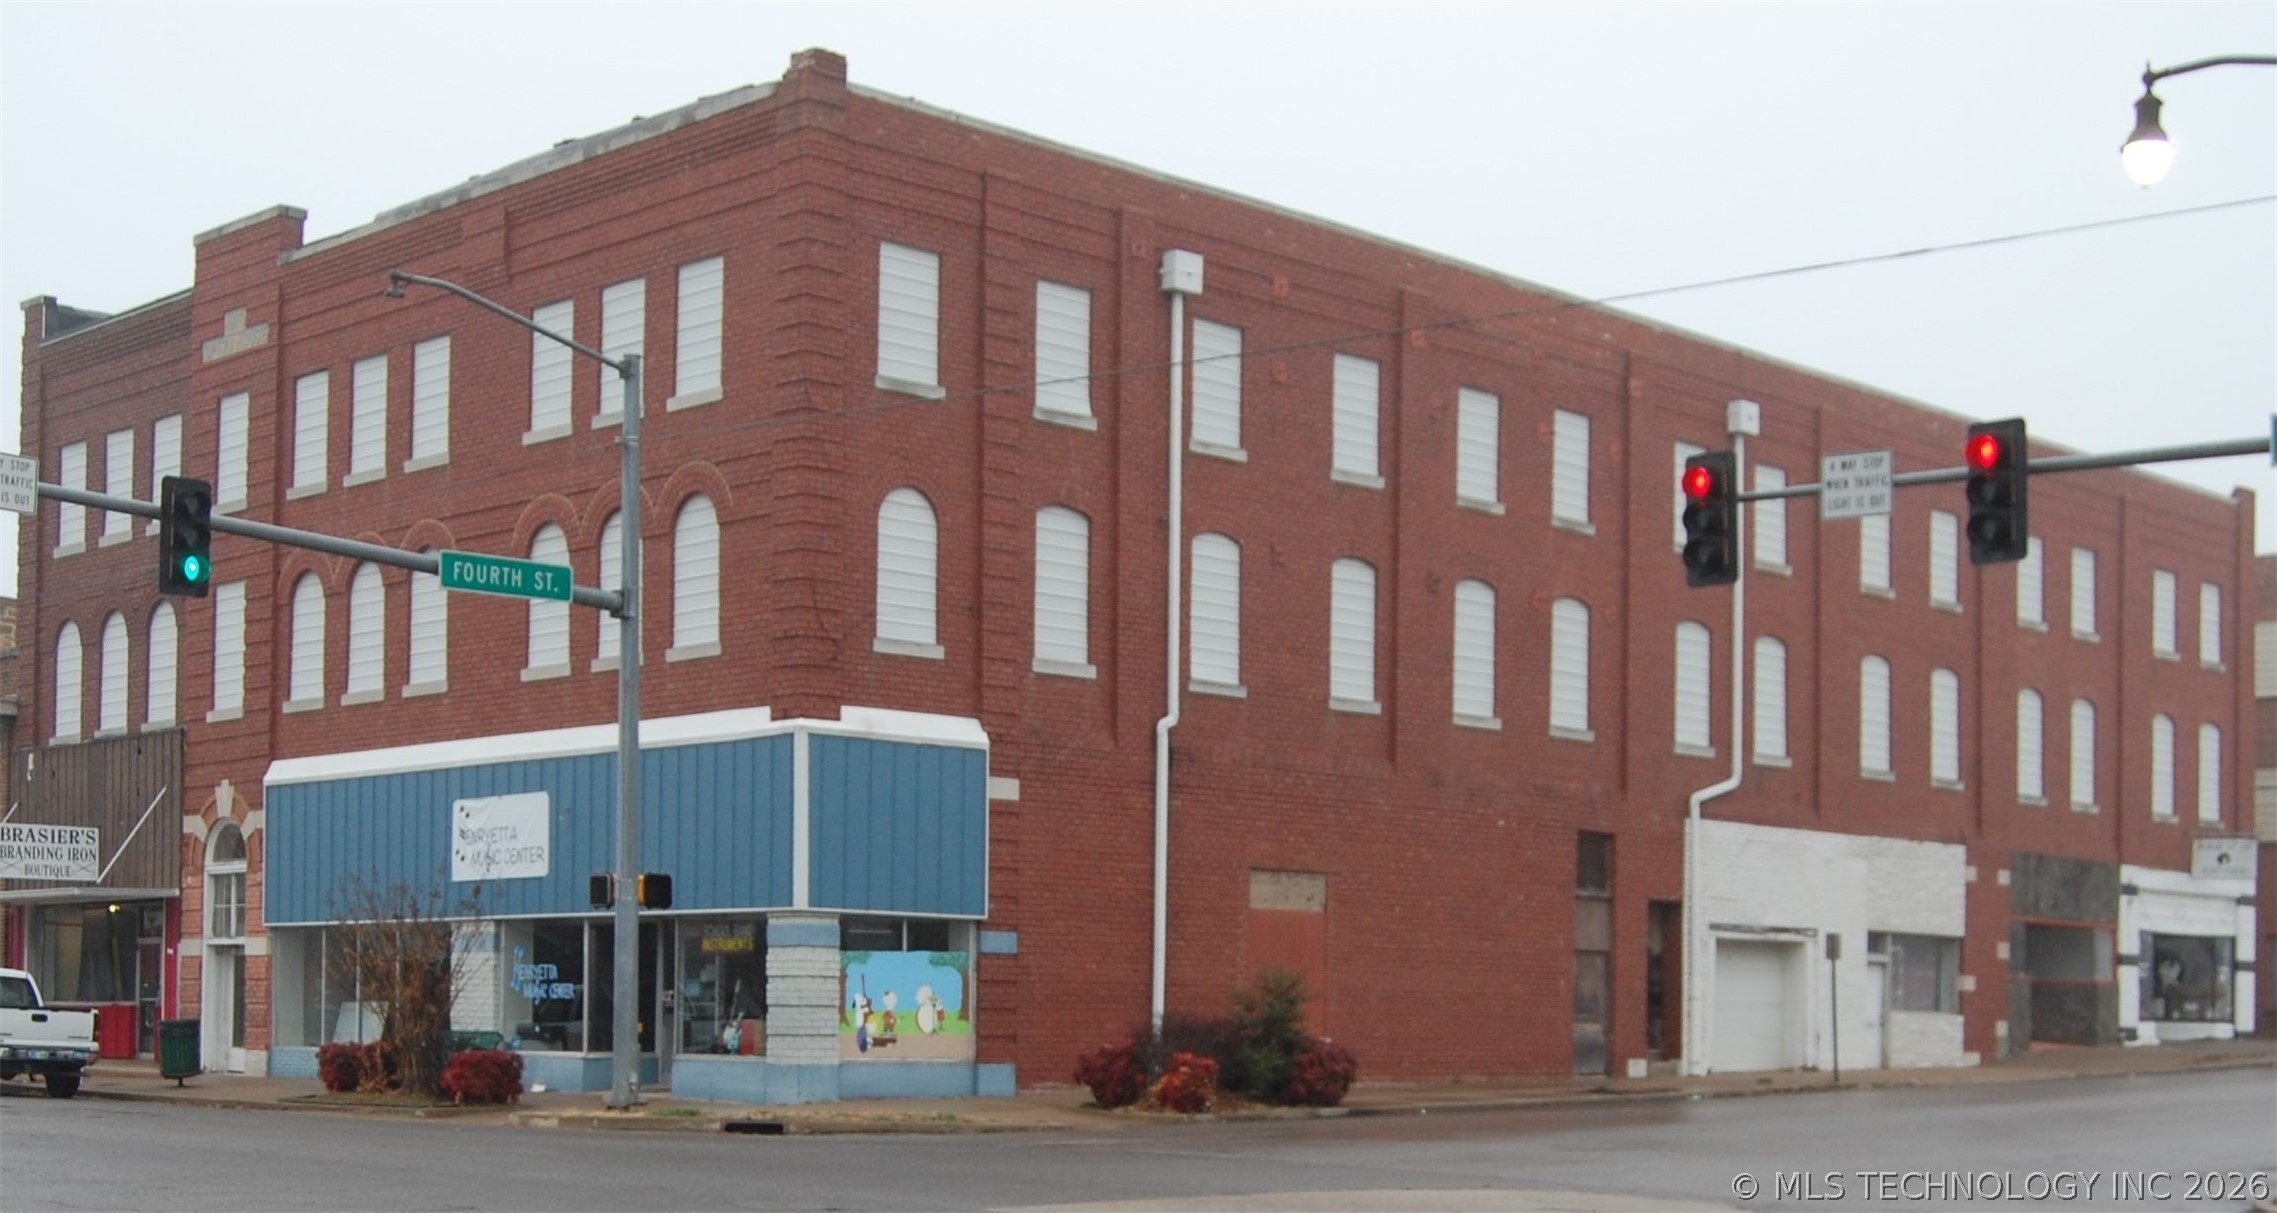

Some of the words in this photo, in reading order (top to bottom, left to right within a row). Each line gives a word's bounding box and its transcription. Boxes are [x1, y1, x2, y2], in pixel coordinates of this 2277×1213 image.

[10, 459, 31, 472] STOP
[1863, 455, 1884, 470] STOP
[0, 473, 33, 490] TRAFFIC
[14, 493, 30, 506] OUT
[453, 561, 522, 587] FOURTH
[533, 570, 559, 593] ST.
[0, 826, 96, 845] BRASIER'S
[0, 845, 64, 861] BRANDING
[68, 847, 97, 863] IRON
[504, 845, 545, 865] CENTER
[24, 863, 72, 878] BOUTIQUE
